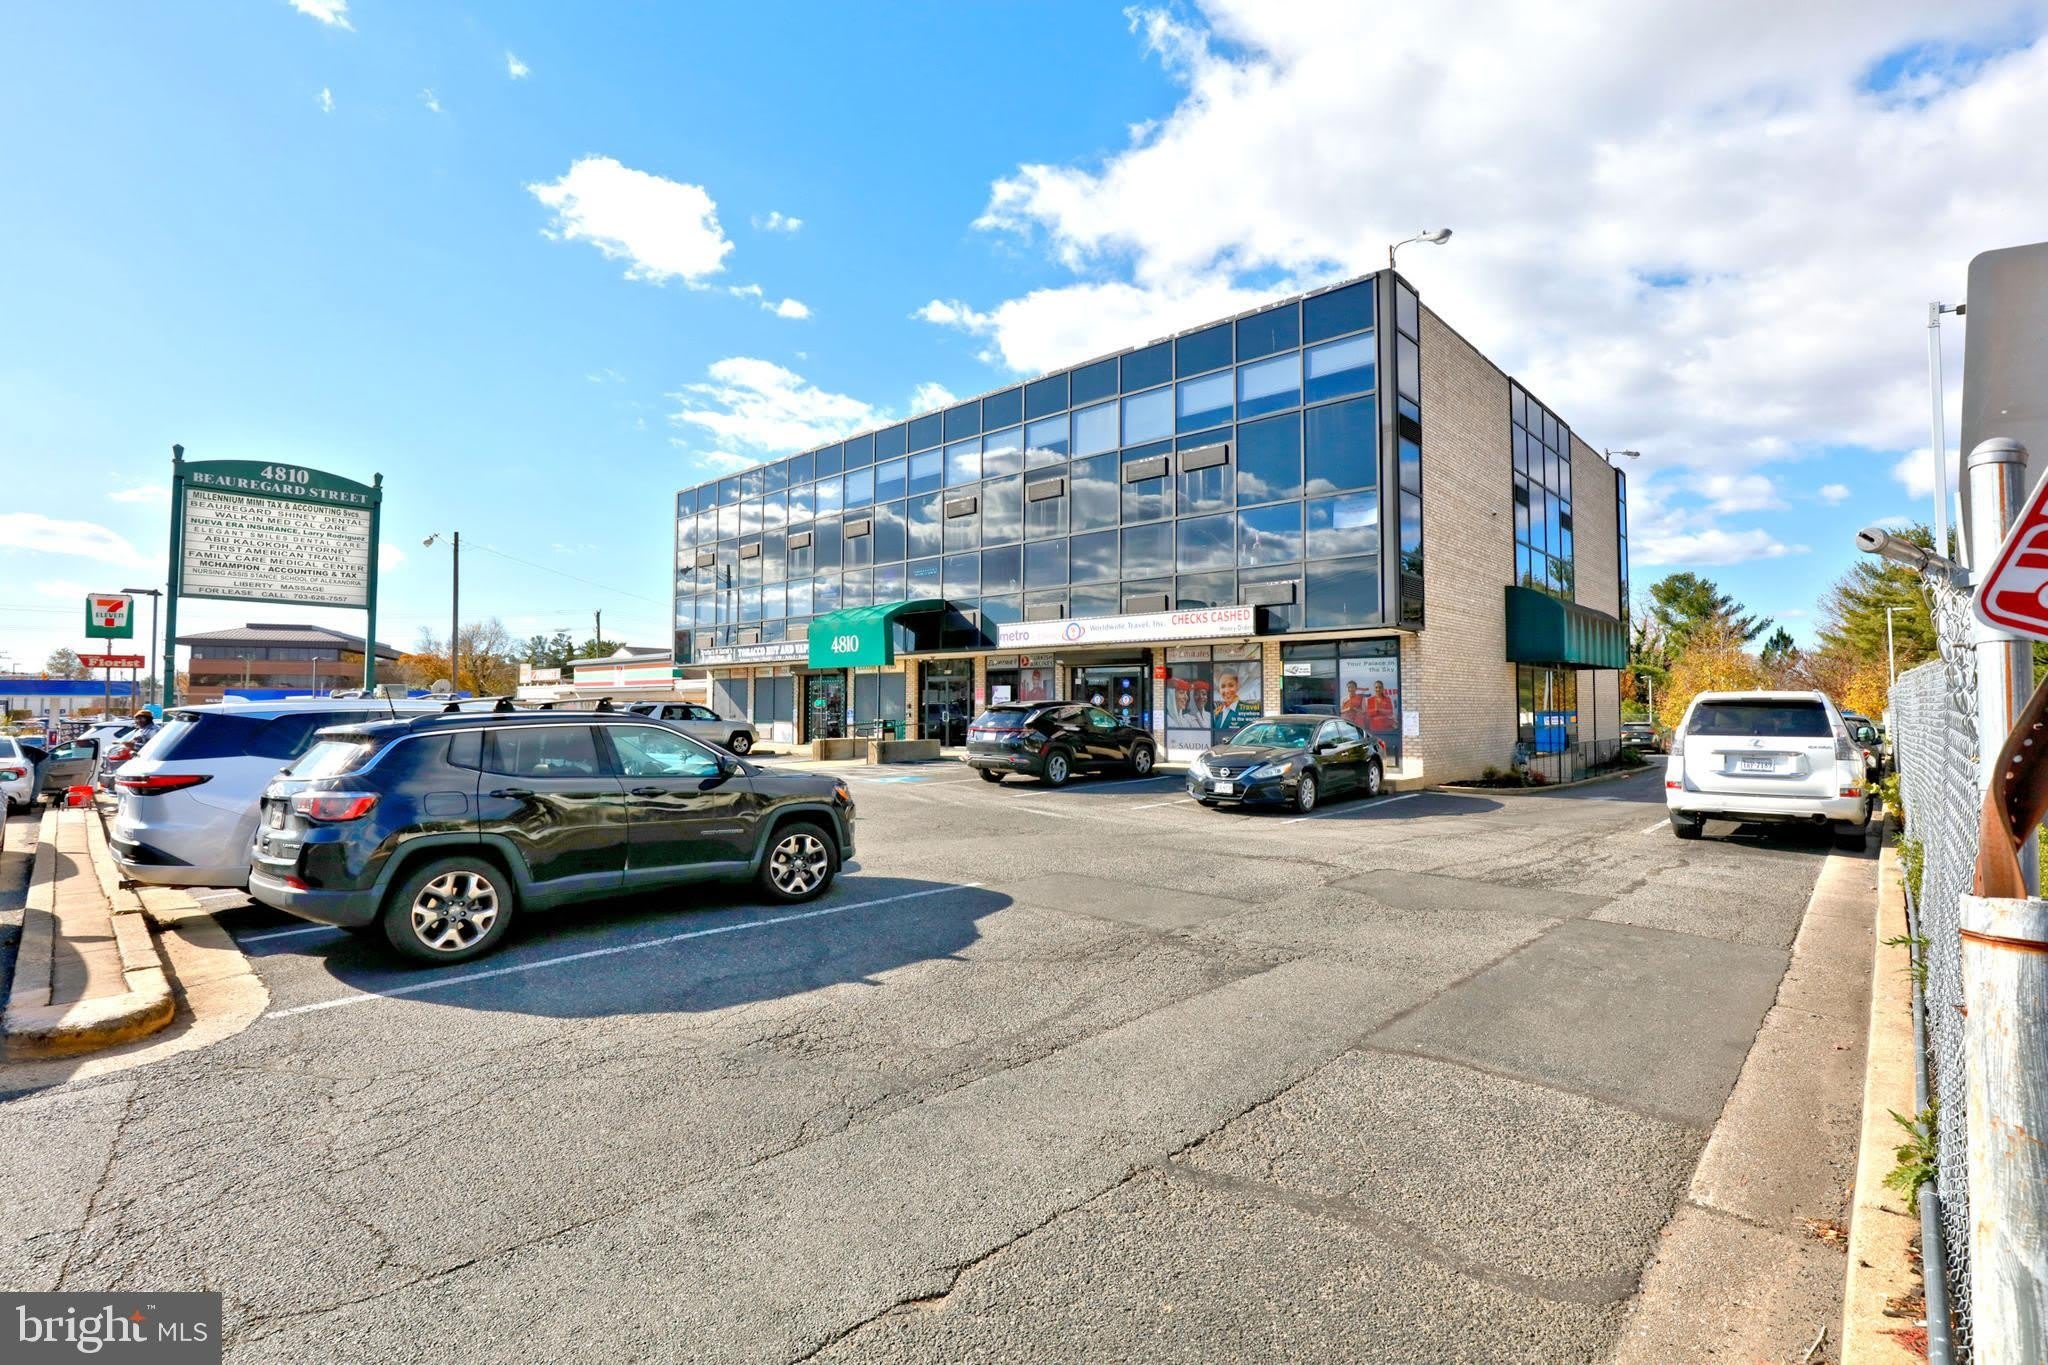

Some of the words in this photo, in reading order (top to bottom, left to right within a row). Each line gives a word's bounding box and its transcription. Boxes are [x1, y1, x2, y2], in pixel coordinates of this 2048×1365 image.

[260, 466, 310, 484] 4810
[193, 472, 306, 495] BEAUREGARD
[309, 488, 368, 504] STREET
[192, 491, 244, 504] MILLENNIUM
[246, 498, 264, 506] MIMI
[267, 501, 282, 509] TAX
[292, 504, 341, 516] ACCOUNTING
[190, 500, 272, 515] BEAUREGARD
[278, 511, 316, 520] SHINEY
[324, 517, 362, 526] DENTAL
[215, 512, 263, 522] WALK-IN
[194, 527, 243, 536] ELEGANT
[250, 532, 288, 541] SMILES
[293, 537, 330, 545] DENTAL
[327, 532, 365, 542] Rodriguez
[209, 544, 242, 552] FIRST
[245, 548, 304, 558] AMERICAN
[308, 554, 348, 562] TRAVEL
[296, 545, 351, 554] ATTORNEY
[188, 551, 230, 559] FAMILY
[270, 558, 318, 567] MEDICAL
[200, 560, 260, 571] MCHAMPION
[268, 566, 328, 576] ACCOUNTING
[97, 600, 123, 626] 7
[1171, 612, 1208, 626] CHECKS
[1211, 609, 1250, 623] CASHED
[1000, 630, 1029, 641] metro
[1090, 623, 1125, 632] Worldwide
[795, 644, 809, 654] VAP
[831, 635, 859, 653] 4810
[88, 658, 140, 666] Florist
